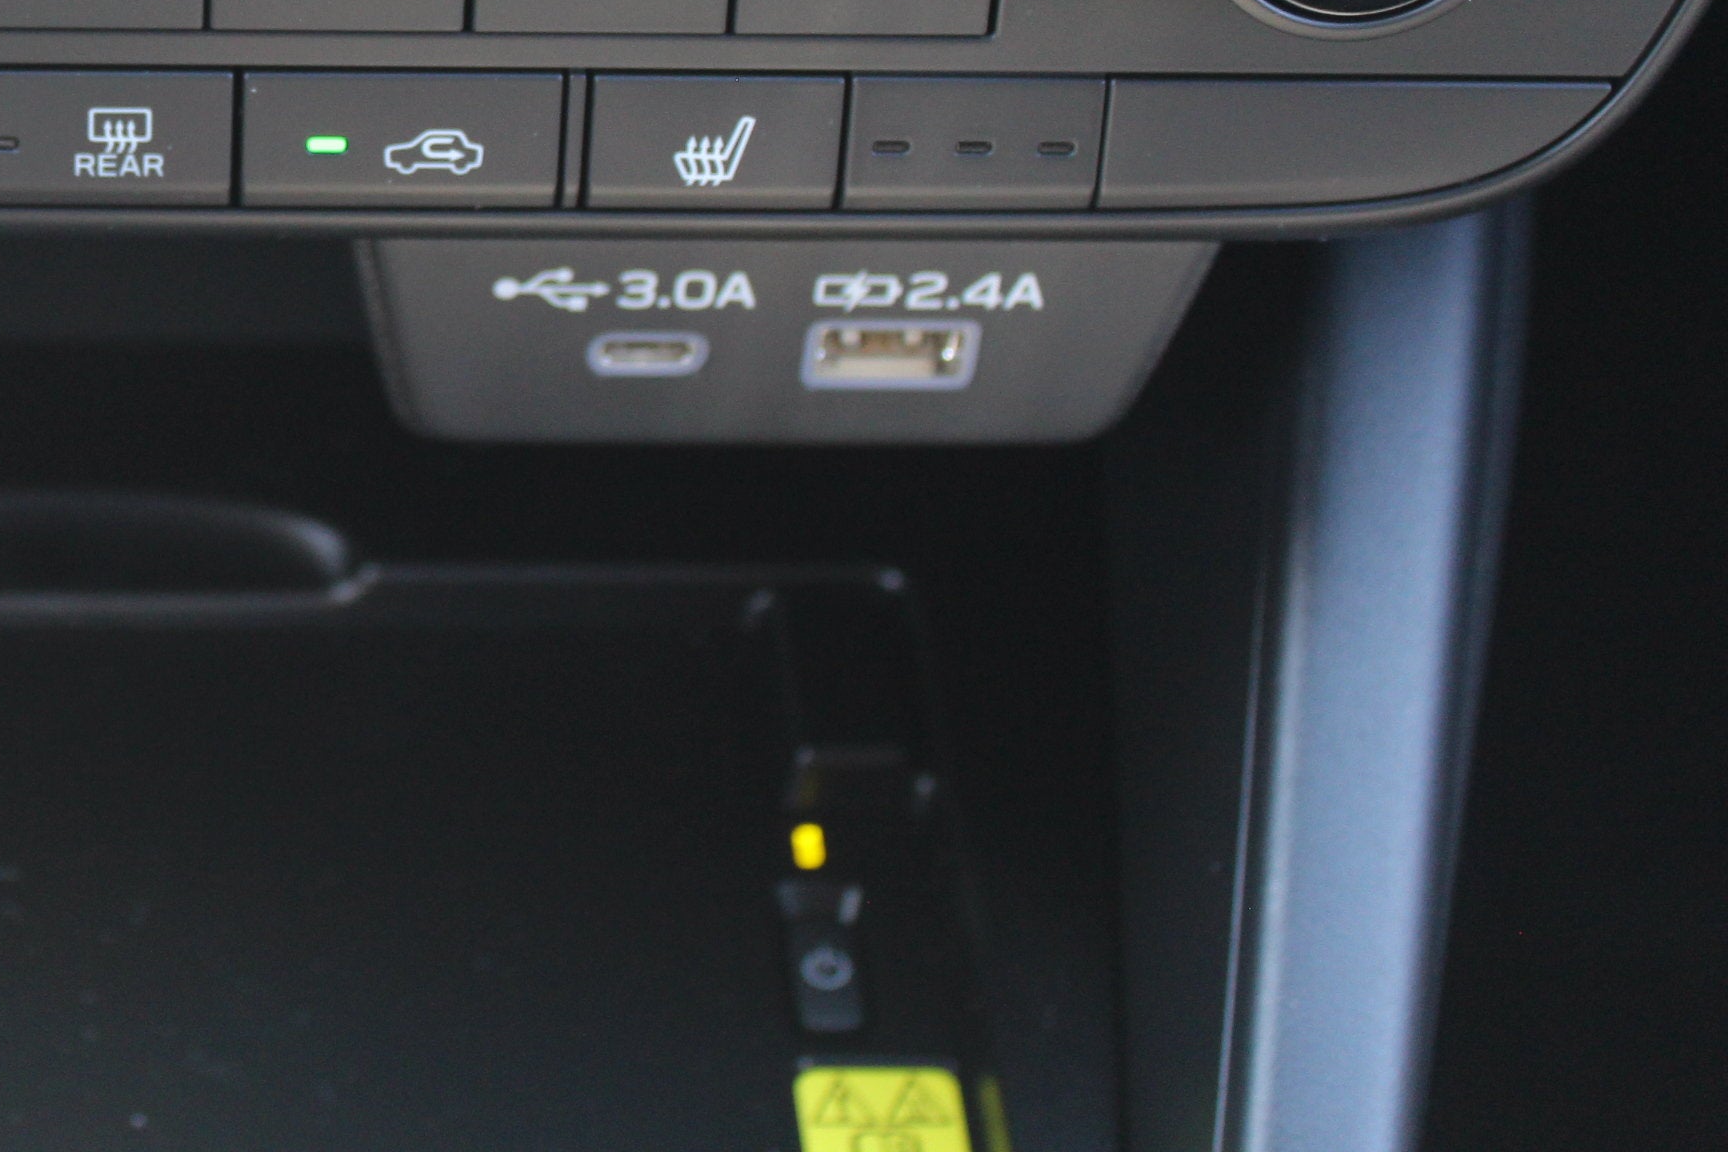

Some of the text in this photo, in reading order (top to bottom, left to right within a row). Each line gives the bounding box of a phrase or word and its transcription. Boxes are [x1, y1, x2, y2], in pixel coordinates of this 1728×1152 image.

[75, 153, 164, 177] REAR
[616, 271, 756, 310] 3.0A
[906, 272, 1043, 310] 2.4A
